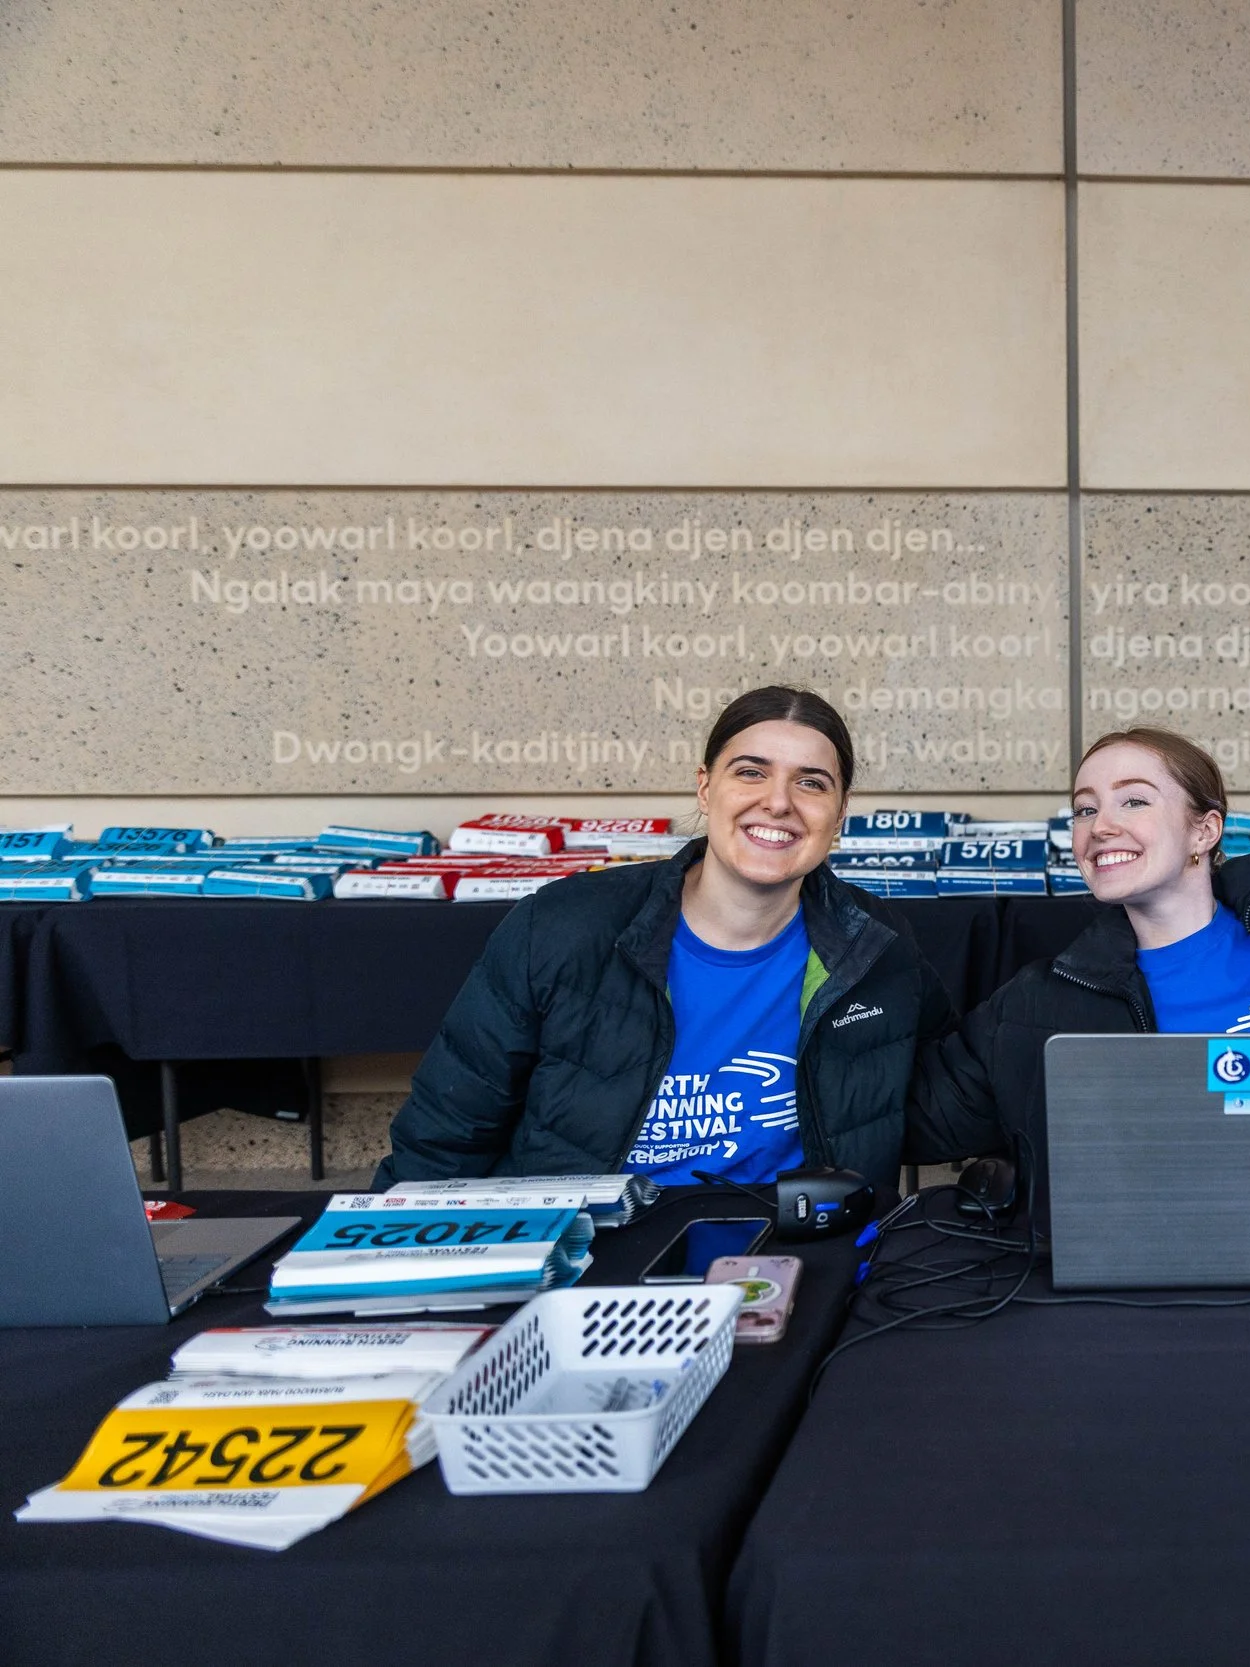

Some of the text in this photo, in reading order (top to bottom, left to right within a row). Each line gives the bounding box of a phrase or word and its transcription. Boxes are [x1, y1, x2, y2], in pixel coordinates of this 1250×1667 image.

[92, 516, 209, 556] koorl,
[224, 518, 395, 560] yoowarl
[409, 517, 527, 556] koorl,
[538, 518, 653, 560] djena
[665, 518, 753, 560] djen
[766, 518, 853, 560] djen
[867, 518, 986, 560] djen...
[191, 571, 341, 614] Ngalak
[357, 578, 474, 614] maya
[490, 571, 718, 614] waangkiny
[732, 571, 1061, 614] koombar-abiny,
[1090, 573, 1170, 614] yira
[461, 625, 630, 658] Yoowarl
[642, 626, 756, 662] koorl,
[769, 627, 939, 666] yoowarl
[949, 627, 1061, 662] koorl,
[1090, 626, 1203, 667] djena
[843, 678, 1064, 720] demangka
[273, 731, 656, 773] Dwongk-kaditjiny,
[580, 819, 656, 834] 19226
[862, 812, 922, 829] 1801
[0, 833, 46, 849] 151
[116, 828, 189, 842] 13576
[961, 841, 1024, 859] 5751
[832, 1006, 884, 1029] Kathmandu
[658, 1074, 710, 1096] RTH
[646, 1092, 744, 1120] UNNING
[637, 1115, 742, 1141] ESTIVAL
[654, 1142, 690, 1150] SUPPORTING
[326, 1220, 530, 1249] 14025
[288, 1338, 406, 1347] PERTH RUNNING
[285, 1386, 346, 1395] BURSWOOD
[98, 1424, 366, 1487] 22542
